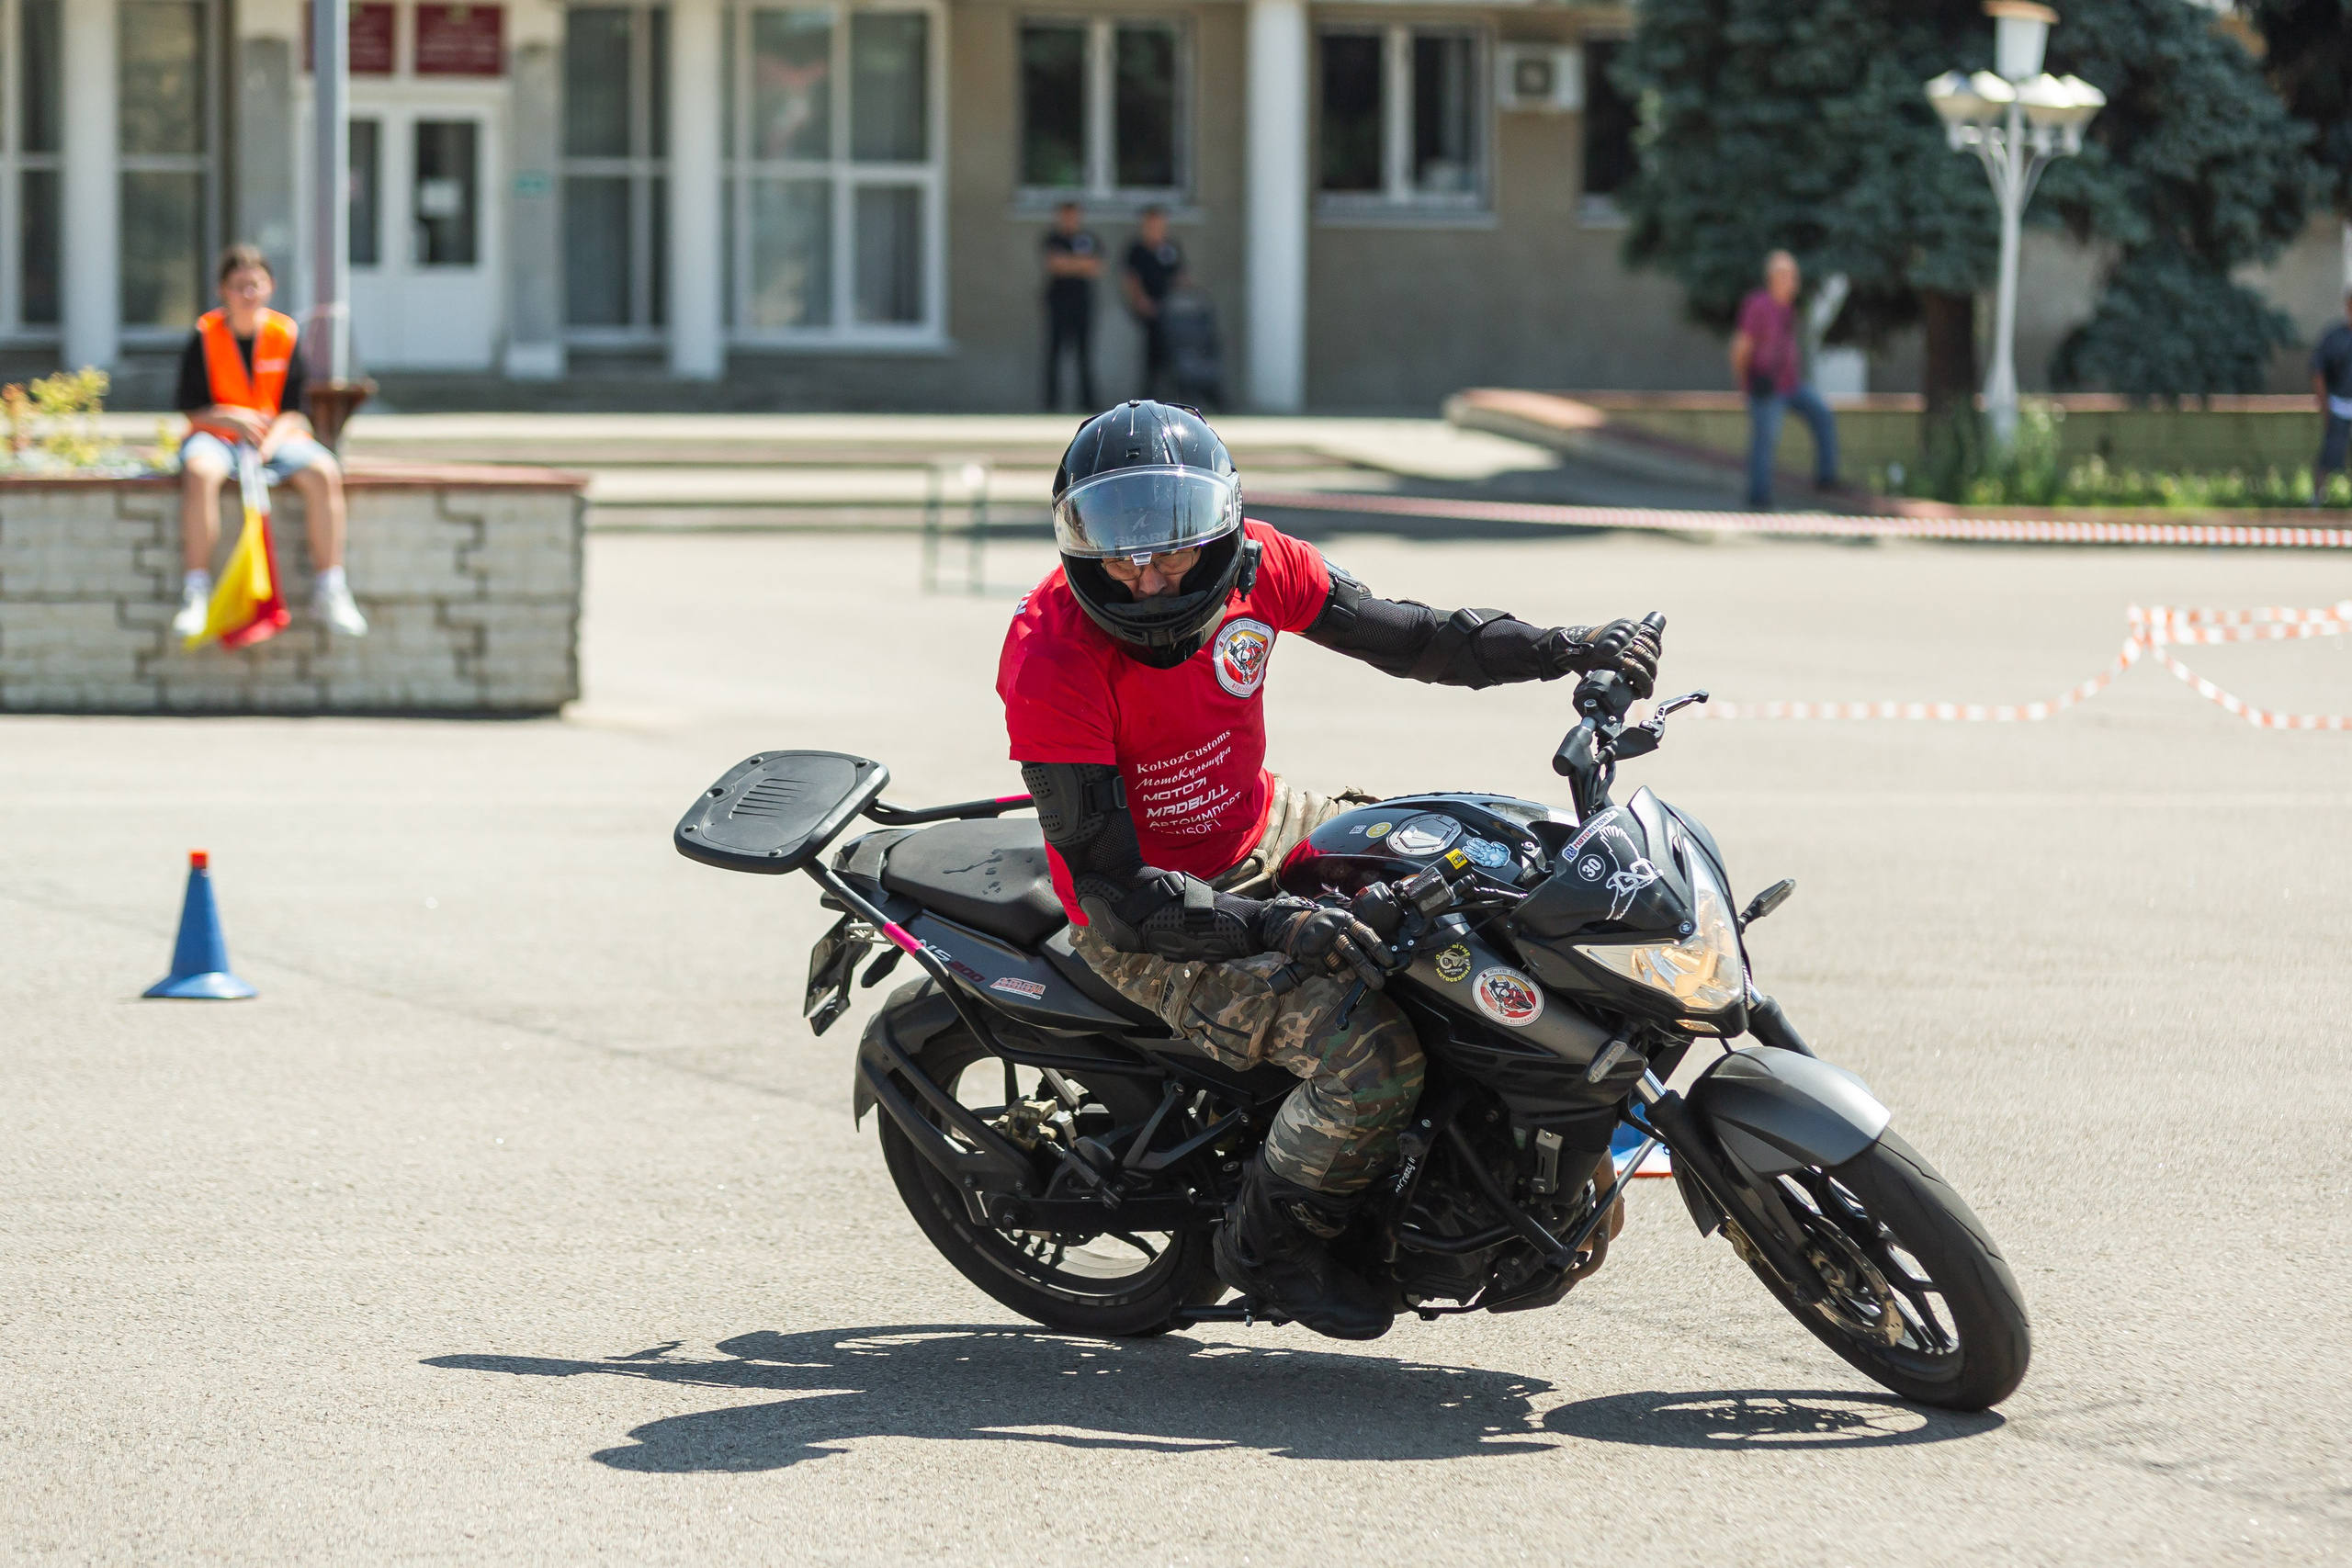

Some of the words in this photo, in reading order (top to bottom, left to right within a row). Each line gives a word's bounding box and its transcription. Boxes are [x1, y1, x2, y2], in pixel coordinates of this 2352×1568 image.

[1135, 745, 1231, 790] МотоКультура
[1136, 729, 1231, 774] KolxozCustoms
[1146, 784, 1229, 818] MADBULL
[1581, 857, 1602, 878] 30
